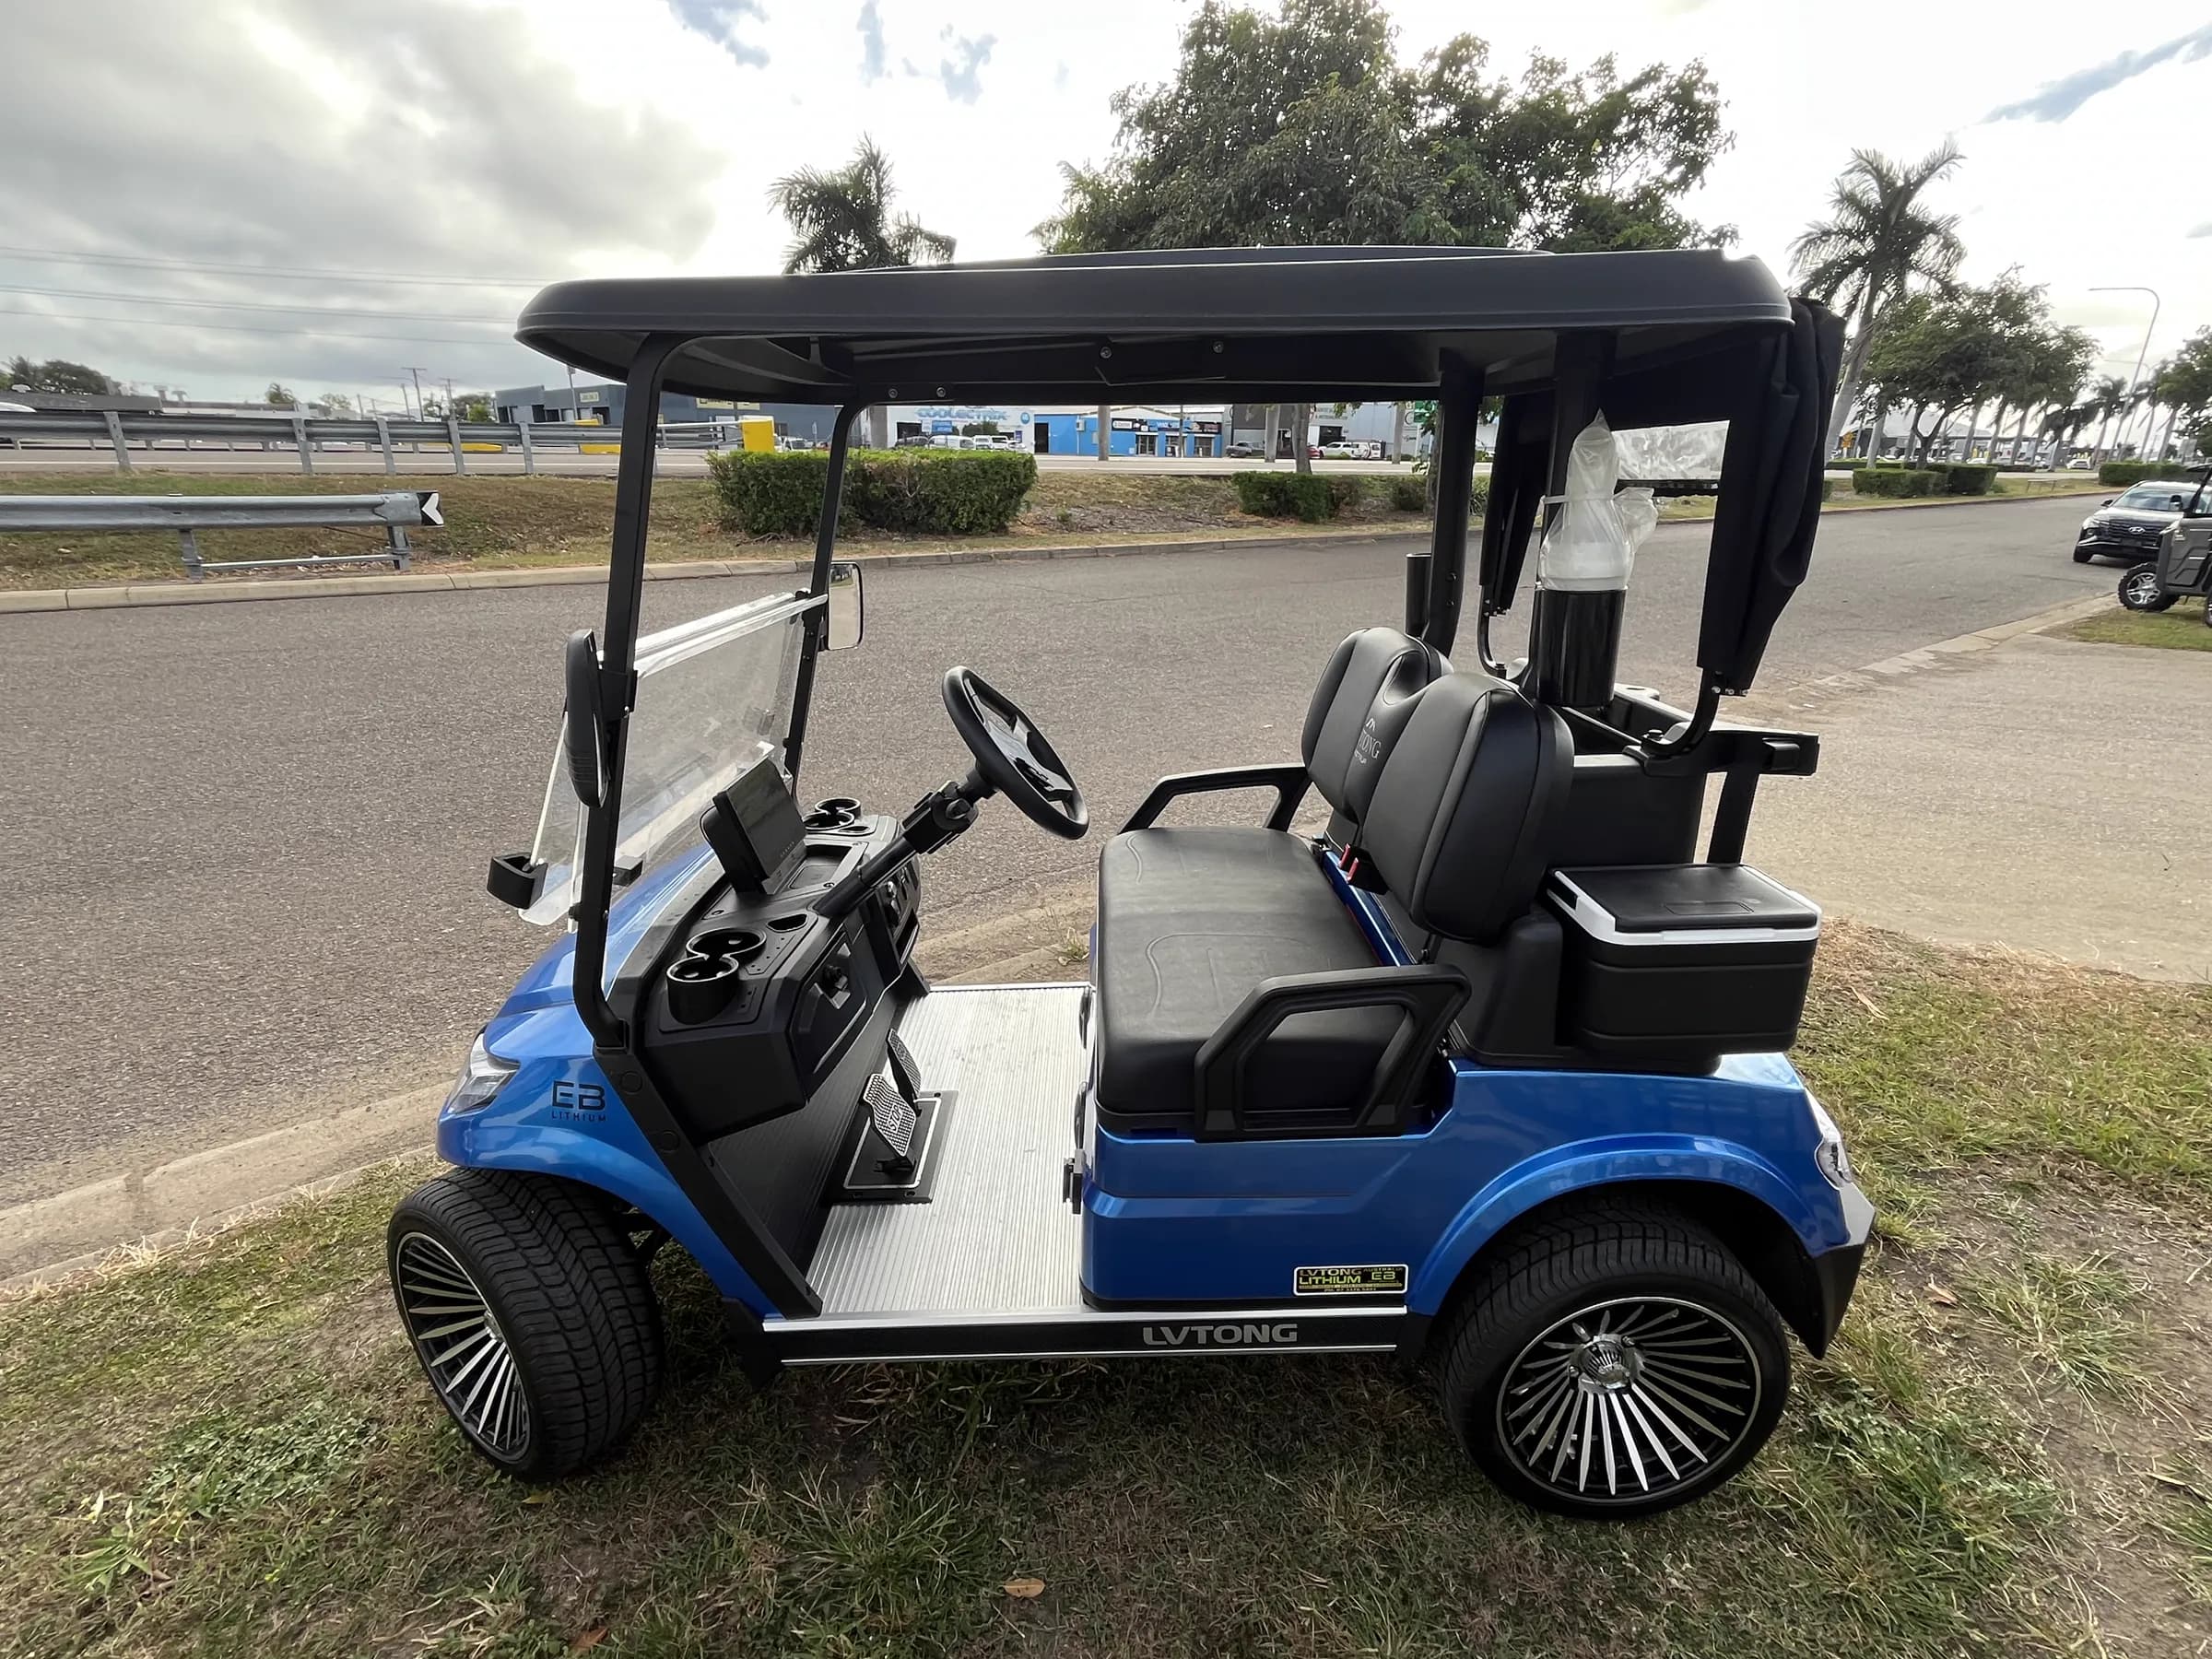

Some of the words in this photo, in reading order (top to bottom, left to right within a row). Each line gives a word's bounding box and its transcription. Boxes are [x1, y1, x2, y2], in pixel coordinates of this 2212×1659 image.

[552, 1111, 606, 1121] LITHIUM
[888, 1104, 901, 1131] STOP
[1300, 1268, 1362, 1277] LVTONG
[1299, 1275, 1361, 1285] LITHIUM
[1142, 1324, 1298, 1345] LVTONG
